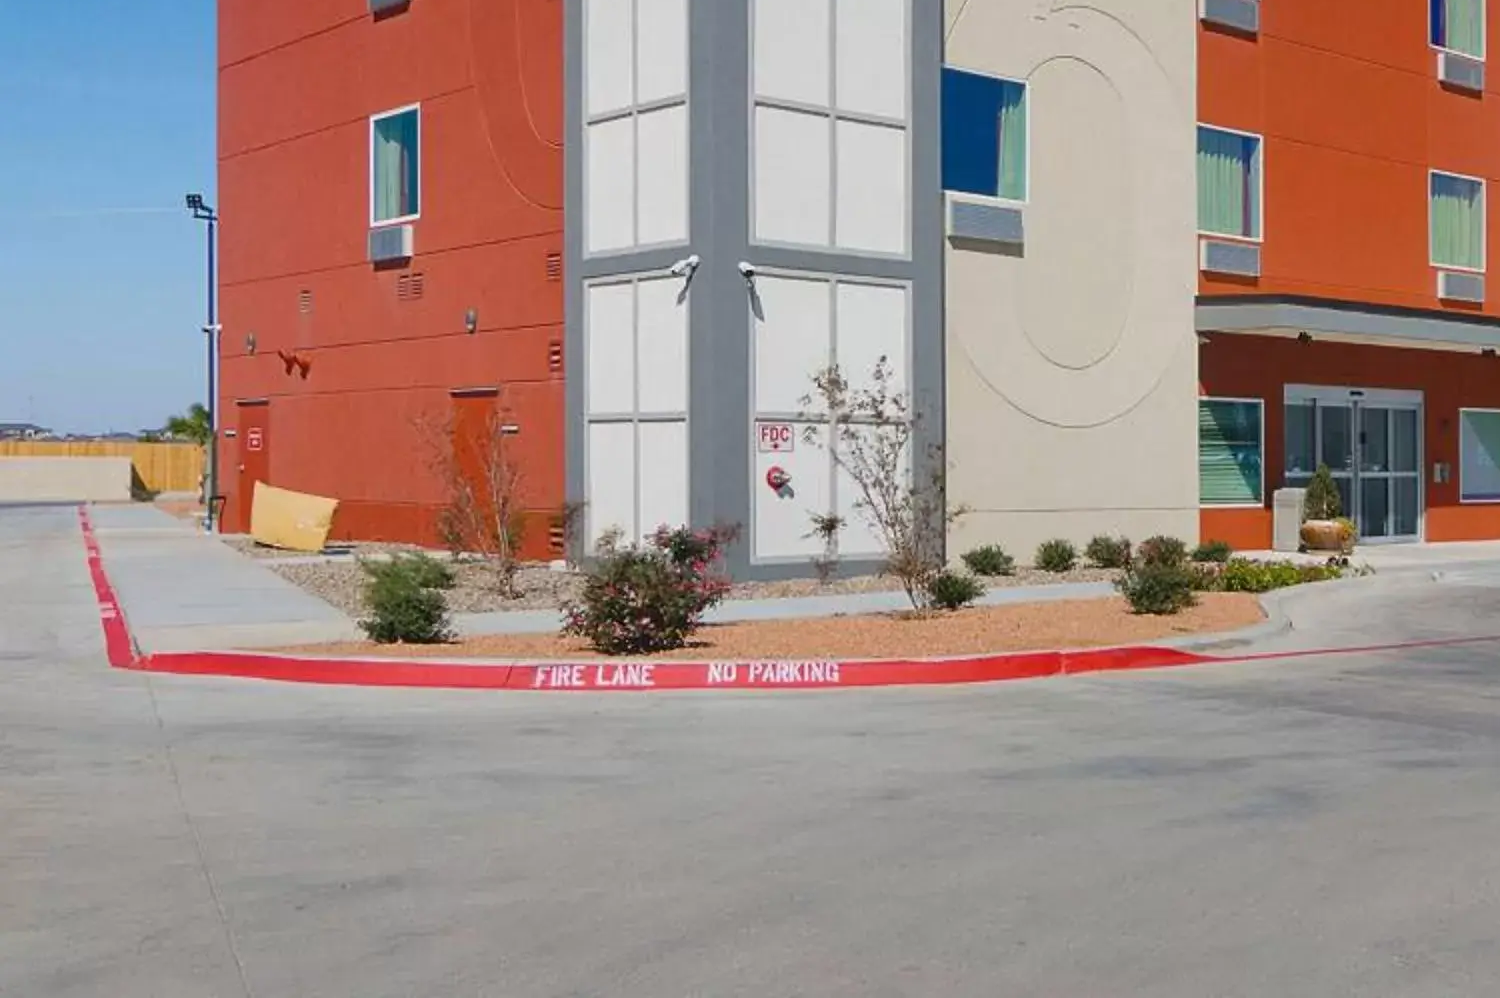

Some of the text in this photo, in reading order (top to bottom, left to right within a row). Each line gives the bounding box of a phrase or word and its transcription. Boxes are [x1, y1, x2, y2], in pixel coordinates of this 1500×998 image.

[761, 426, 790, 443] FDC
[534, 660, 840, 688] FIRE LANE NO PARKING
